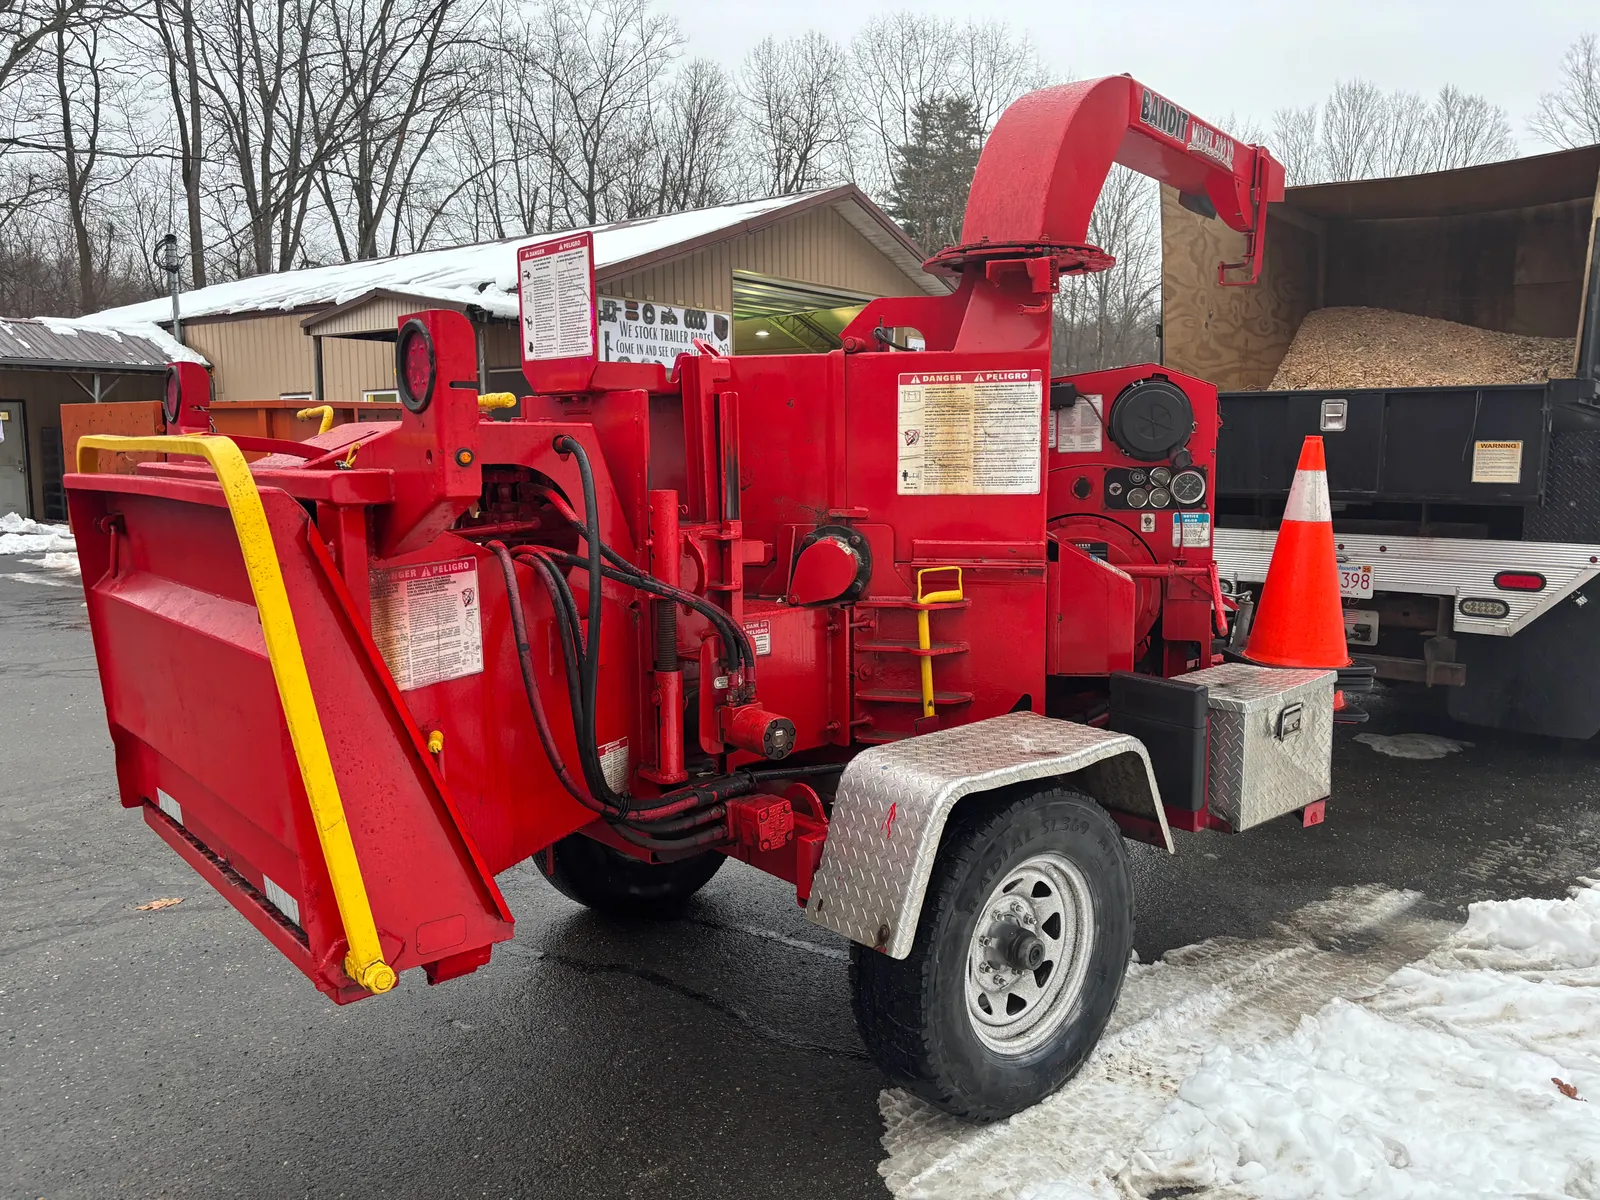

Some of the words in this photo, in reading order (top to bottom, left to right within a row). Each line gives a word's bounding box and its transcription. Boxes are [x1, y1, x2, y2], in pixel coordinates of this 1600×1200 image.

[1139, 88, 1190, 144] BANDIT
[529, 248, 545, 257] DANGER
[563, 240, 581, 249] PELIGRO
[635, 325, 658, 340] STOCK
[660, 328, 689, 344] TRAILER
[616, 339, 634, 354] COME
[637, 343, 644, 355] IN
[645, 344, 657, 356] AND
[658, 346, 670, 357] SEE
[922, 374, 962, 383] DANGER
[986, 372, 1028, 381] PELIGRO
[432, 561, 469, 574] PELIGRO
[1340, 571, 1370, 590] 398
[1041, 816, 1090, 835] SL369
[965, 828, 1035, 916] RADIAL
